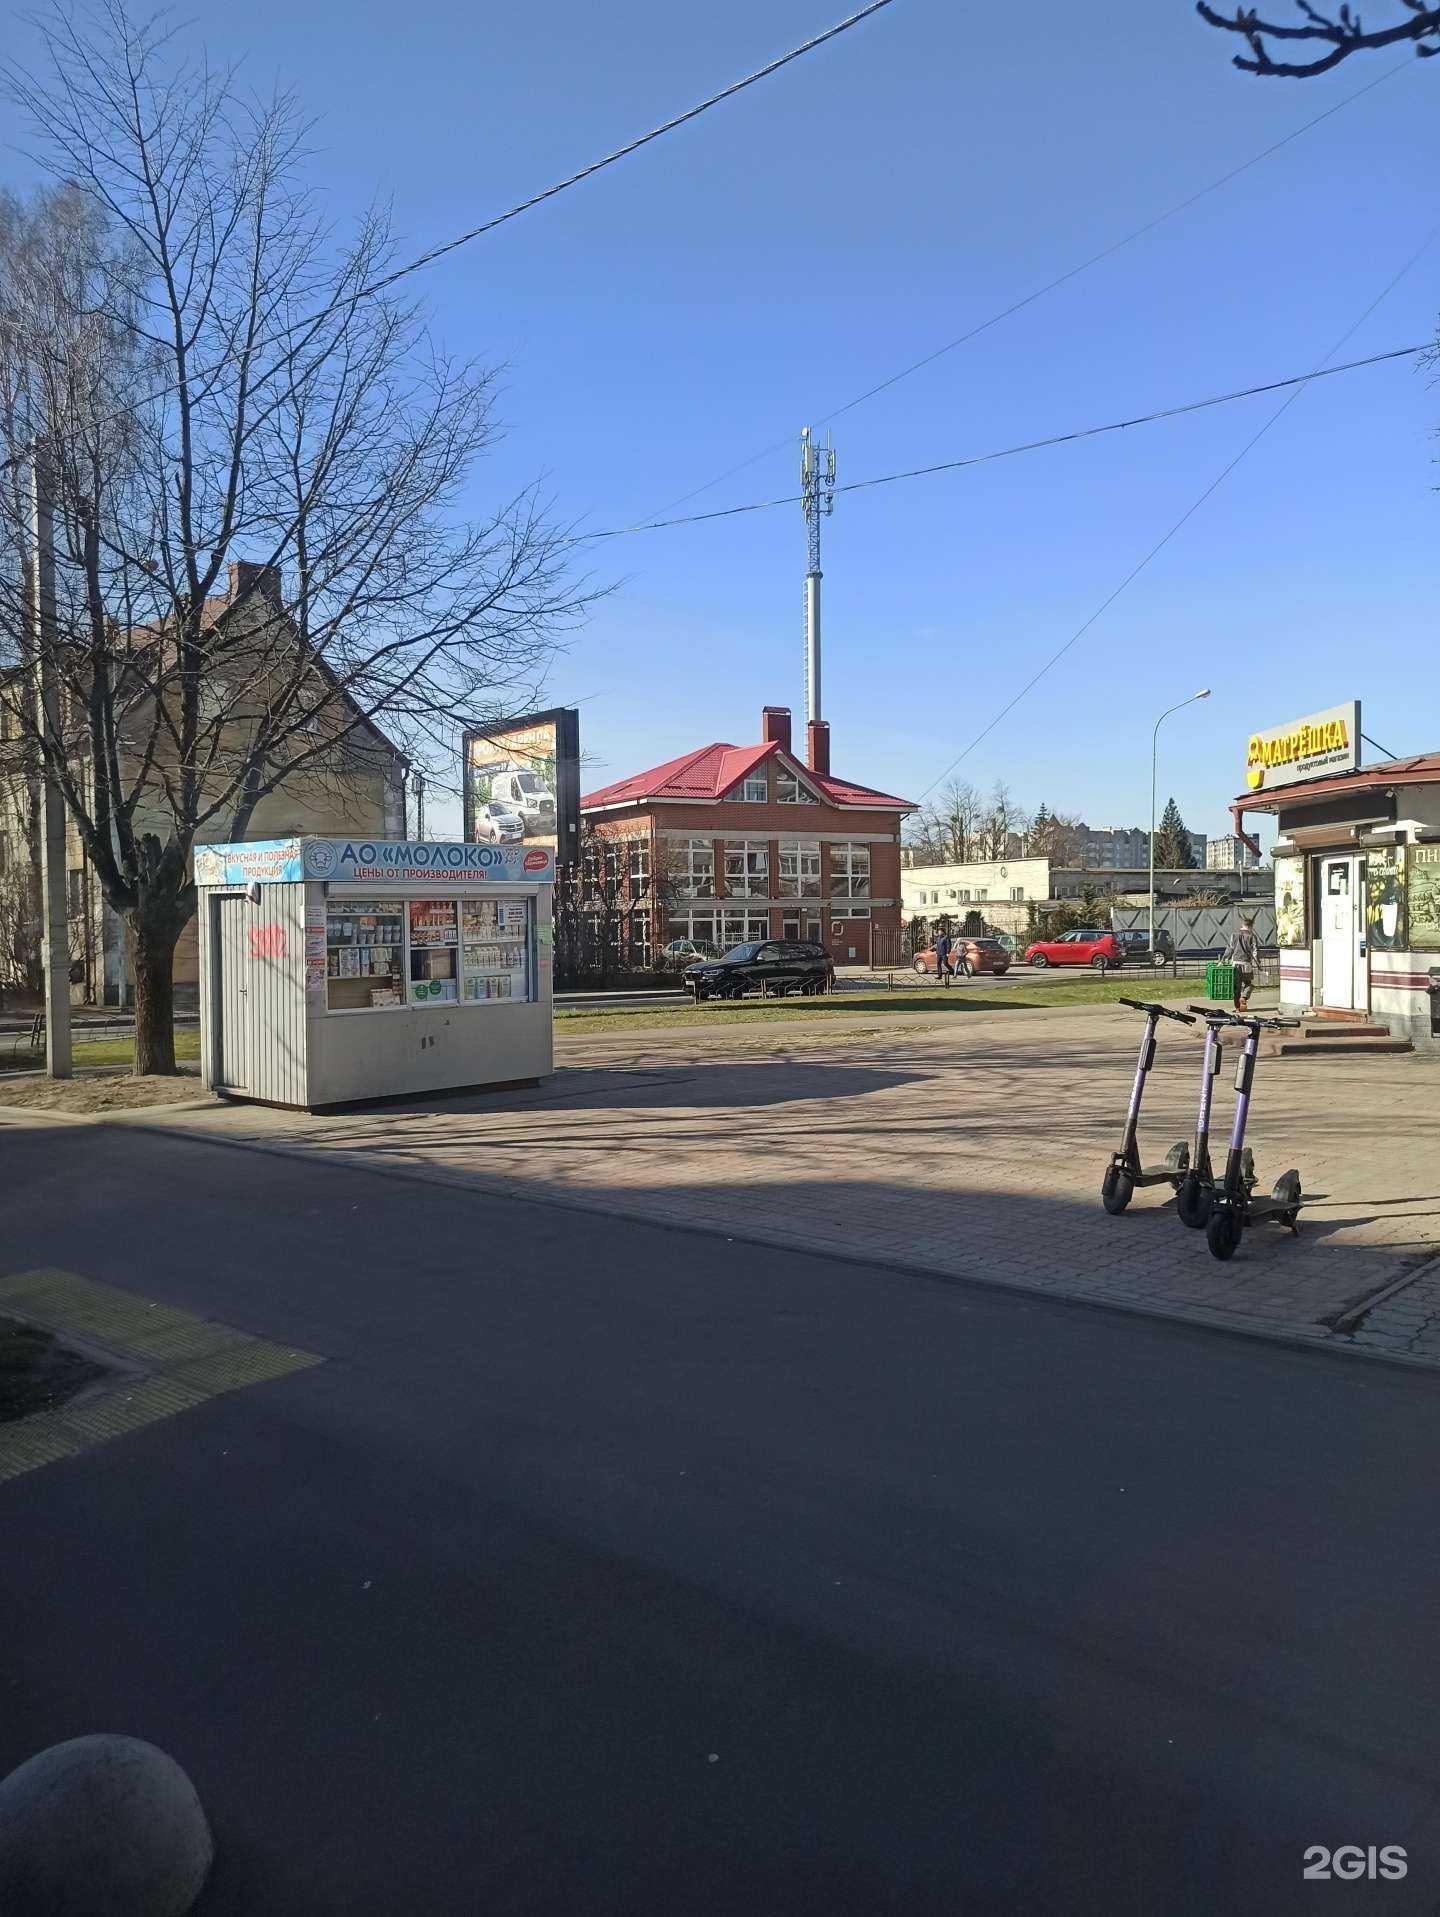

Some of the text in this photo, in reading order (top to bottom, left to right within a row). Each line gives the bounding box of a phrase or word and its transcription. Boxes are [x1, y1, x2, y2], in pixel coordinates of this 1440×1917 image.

[1261, 719, 1349, 769] МАТРЁШКА
[227, 852, 257, 864] ВКУСНАЯ
[258, 851, 263, 862] И
[340, 843, 503, 868] АО «МОЛОКО»
[243, 865, 282, 877] ПРОДУКЦИЯ
[353, 868, 487, 881] ЦЕНЫ ОТ ПРОИЗВОДИТЕЛЯ!
